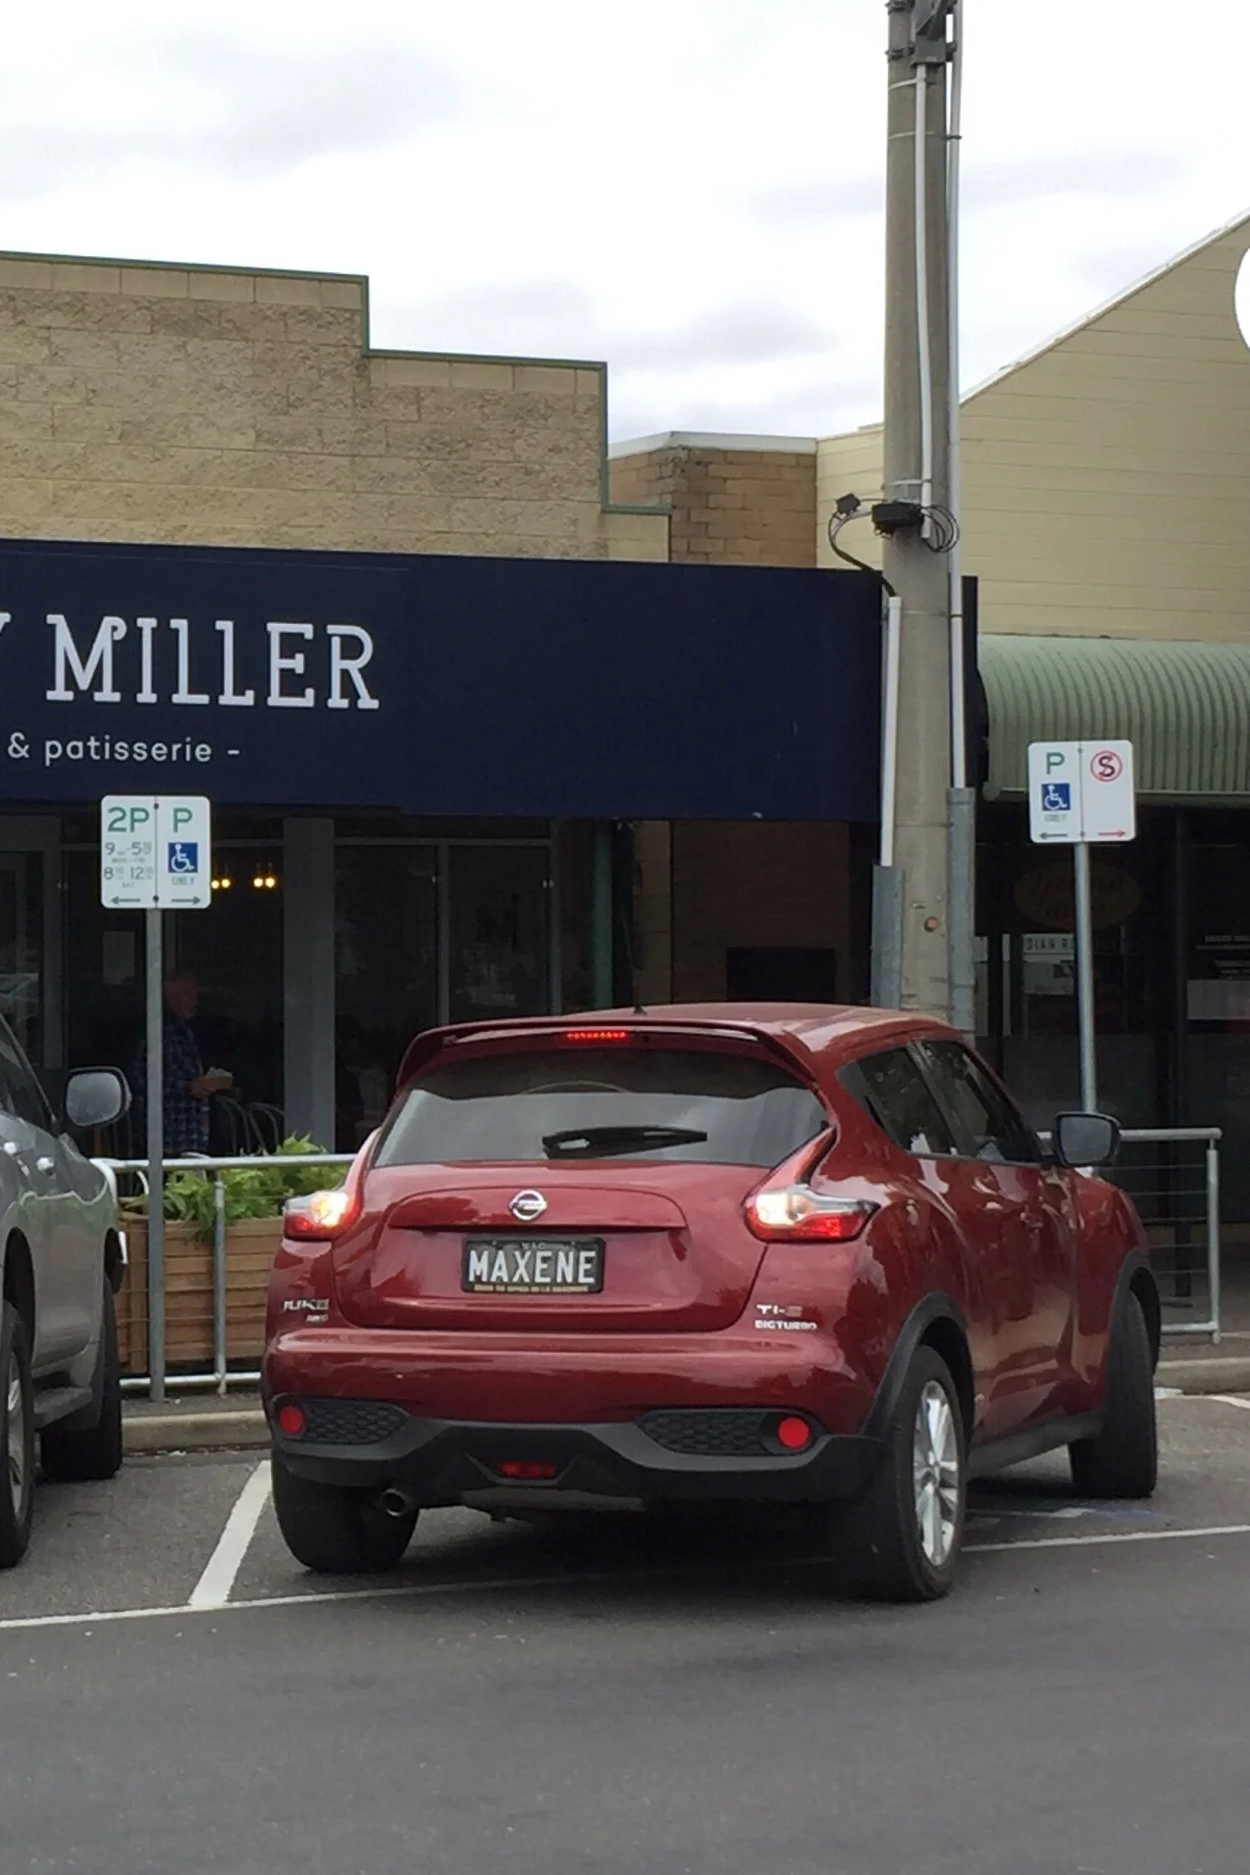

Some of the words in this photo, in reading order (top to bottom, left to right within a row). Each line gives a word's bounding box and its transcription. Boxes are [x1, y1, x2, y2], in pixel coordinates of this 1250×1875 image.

[45, 613, 380, 710] MILLER
[7, 732, 30, 759] &
[44, 734, 212, 767] patisserie
[1046, 751, 1066, 775] P
[107, 806, 149, 833] 2P
[172, 807, 193, 833] P
[468, 1249, 597, 1283] MAXENE
